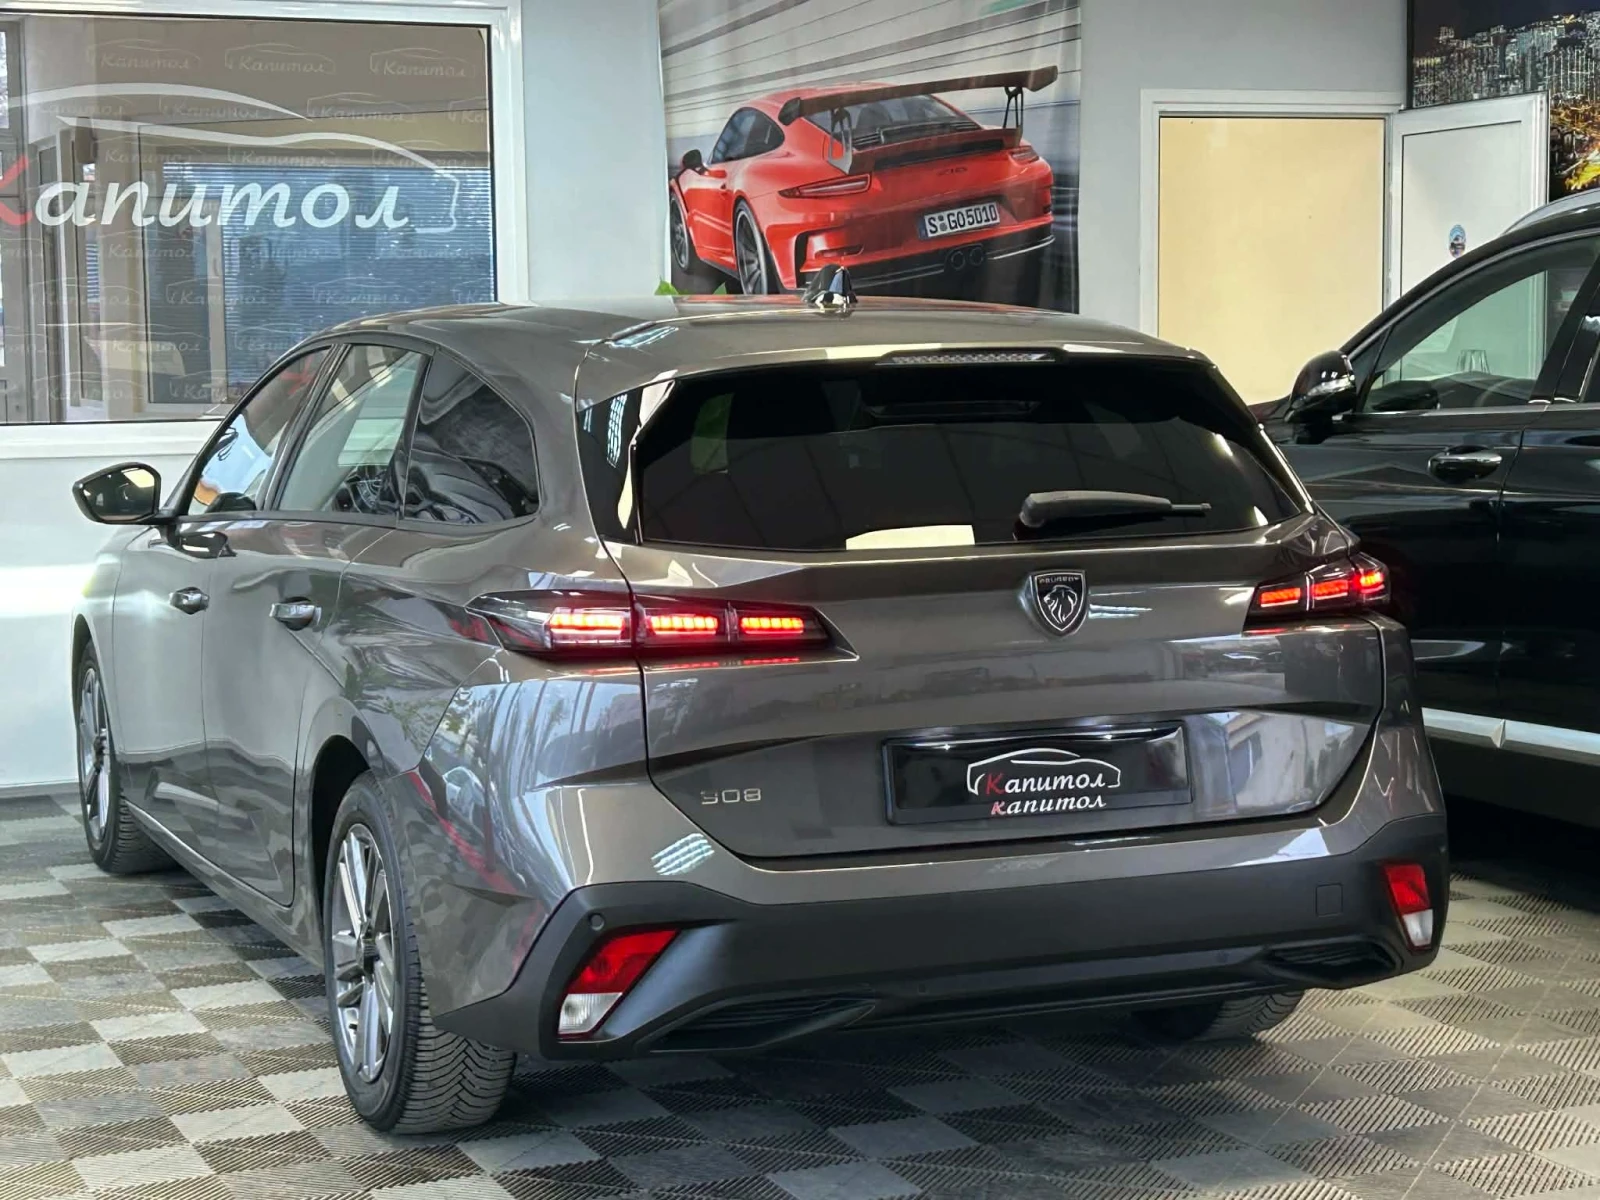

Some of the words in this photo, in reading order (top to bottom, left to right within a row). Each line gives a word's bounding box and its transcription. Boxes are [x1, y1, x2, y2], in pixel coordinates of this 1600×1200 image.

[237, 55, 326, 74] Капитол
[382, 57, 467, 78] Капитол
[985, 772, 1106, 795] Капитол
